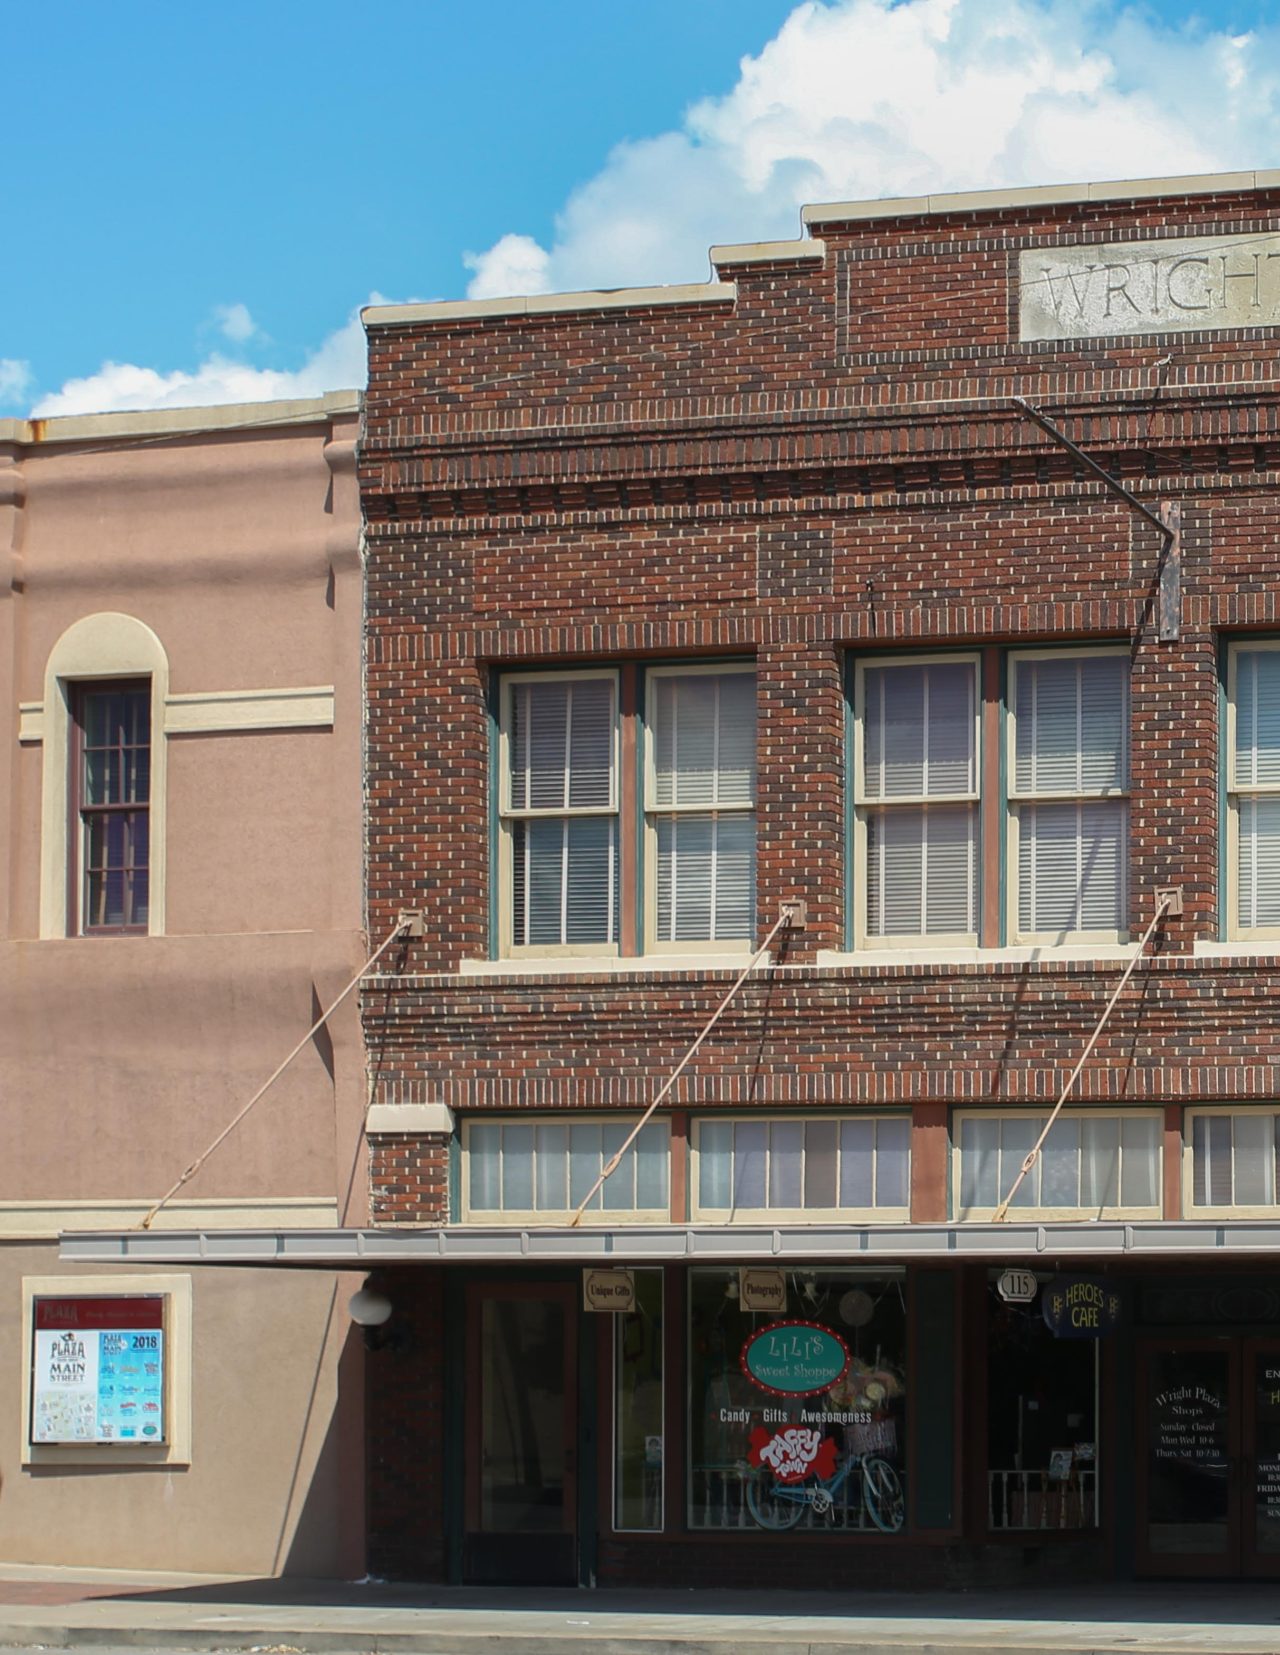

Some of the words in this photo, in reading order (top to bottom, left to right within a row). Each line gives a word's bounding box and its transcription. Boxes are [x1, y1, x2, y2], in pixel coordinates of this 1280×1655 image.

[590, 1284, 614, 1298] Unique
[615, 1284, 630, 1296] Gifts
[747, 1283, 782, 1299] Photography
[1010, 1275, 1029, 1295] 115
[1066, 1283, 1104, 1308] HEROES
[1072, 1307, 1099, 1328] CAFE
[50, 1341, 86, 1359] PLAZA
[132, 1335, 157, 1349] 2018
[769, 1335, 824, 1362] LILI'S
[50, 1363, 85, 1374] MAIN
[756, 1364, 791, 1378] Sweet
[794, 1363, 837, 1380] Shoppe
[1155, 1386, 1192, 1406] Wright
[1195, 1387, 1220, 1408] Plaza
[720, 1408, 750, 1424] Candy
[763, 1408, 788, 1423] Gifts
[800, 1408, 872, 1425] Awesomeness
[1172, 1405, 1204, 1417] Shops
[1160, 1422, 1186, 1433] Sunday
[1192, 1422, 1215, 1432] Closed
[760, 1429, 821, 1468] TAFFY
[776, 1458, 808, 1477] TOWN
